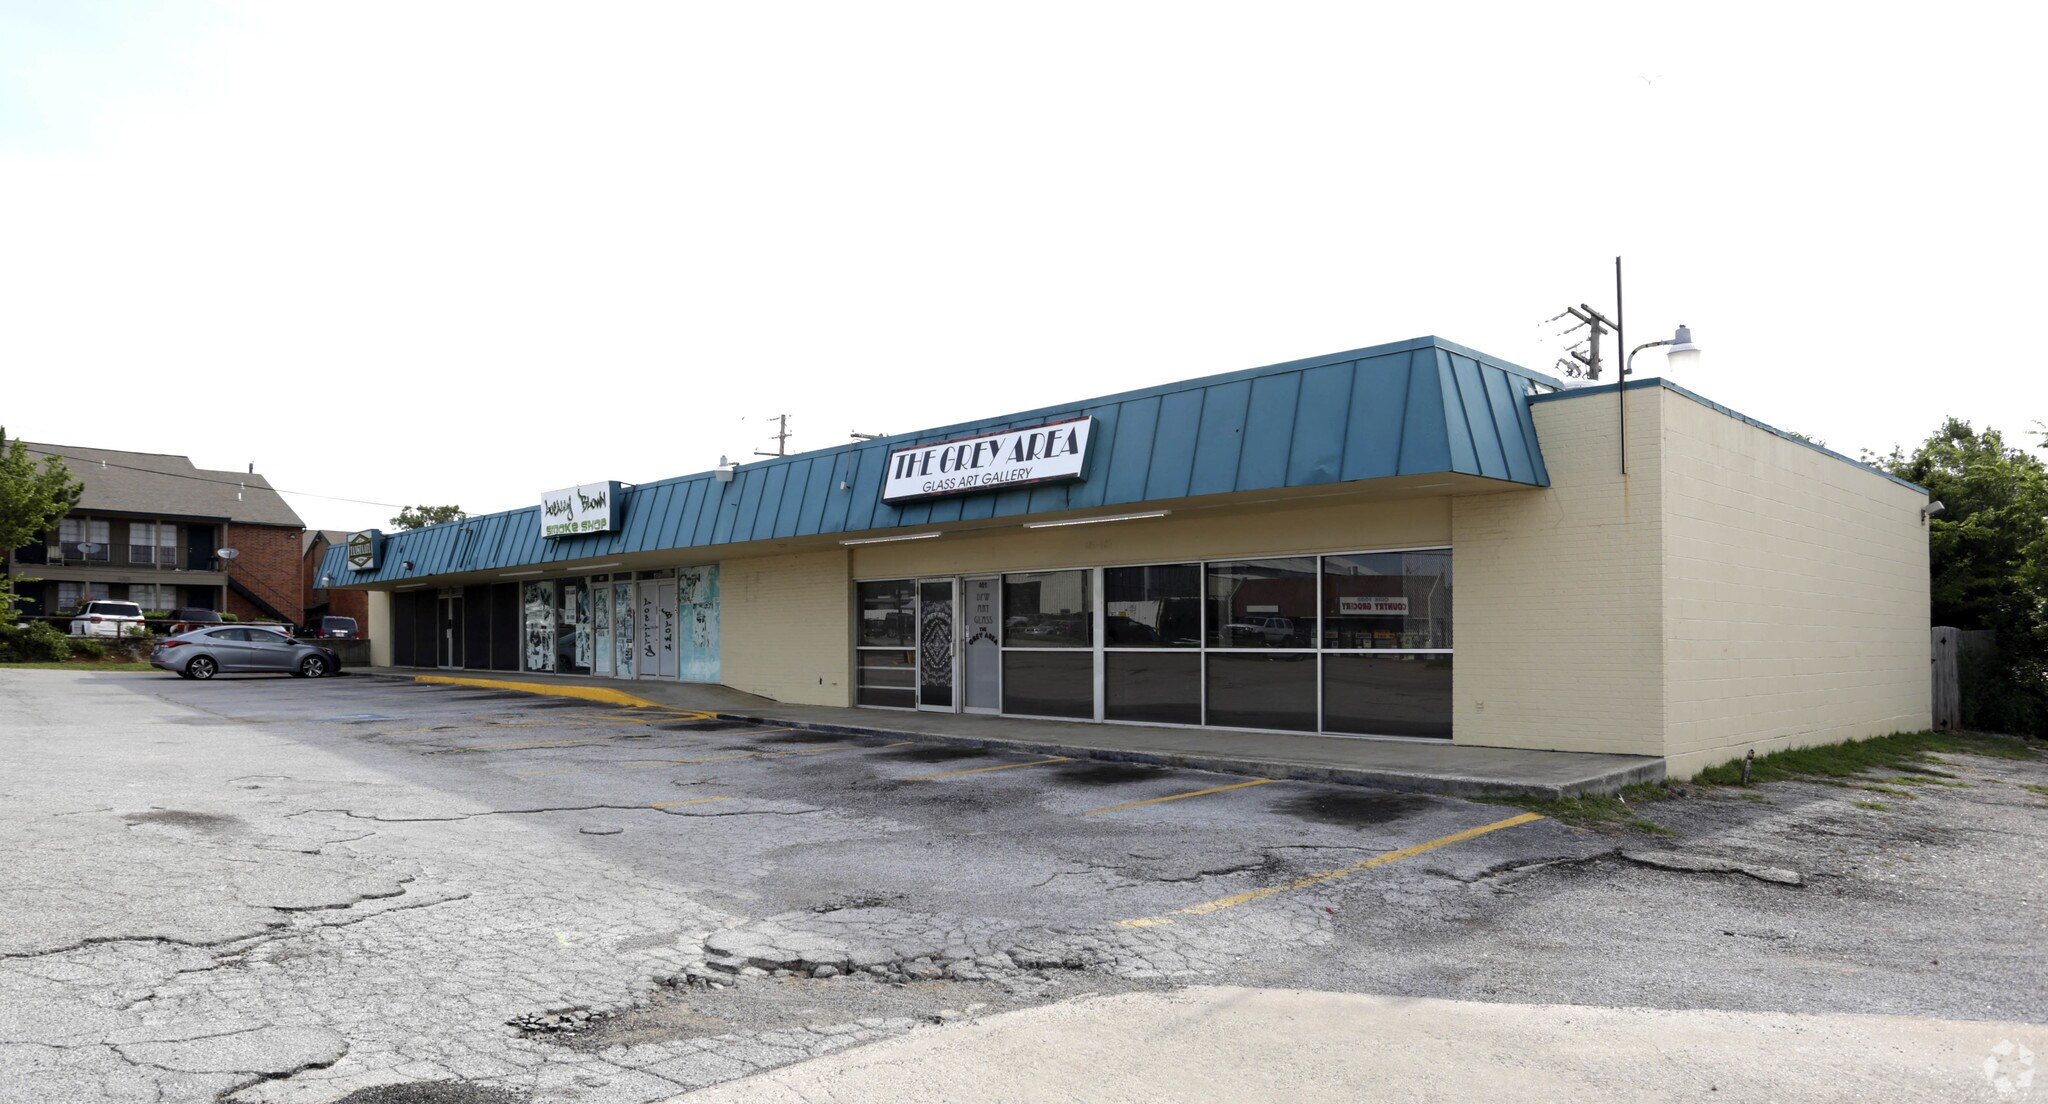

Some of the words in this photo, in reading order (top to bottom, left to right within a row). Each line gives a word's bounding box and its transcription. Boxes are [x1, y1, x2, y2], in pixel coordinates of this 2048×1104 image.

[896, 450, 937, 480] THE
[939, 437, 1006, 474] GREY
[1005, 426, 1079, 464] AREA
[922, 478, 956, 493] GLASS
[957, 474, 980, 488] ART
[981, 467, 1033, 485] GALLERY
[546, 521, 579, 535] SMOKE
[580, 517, 607, 532] SHOP
[974, 616, 993, 624] GLASS
